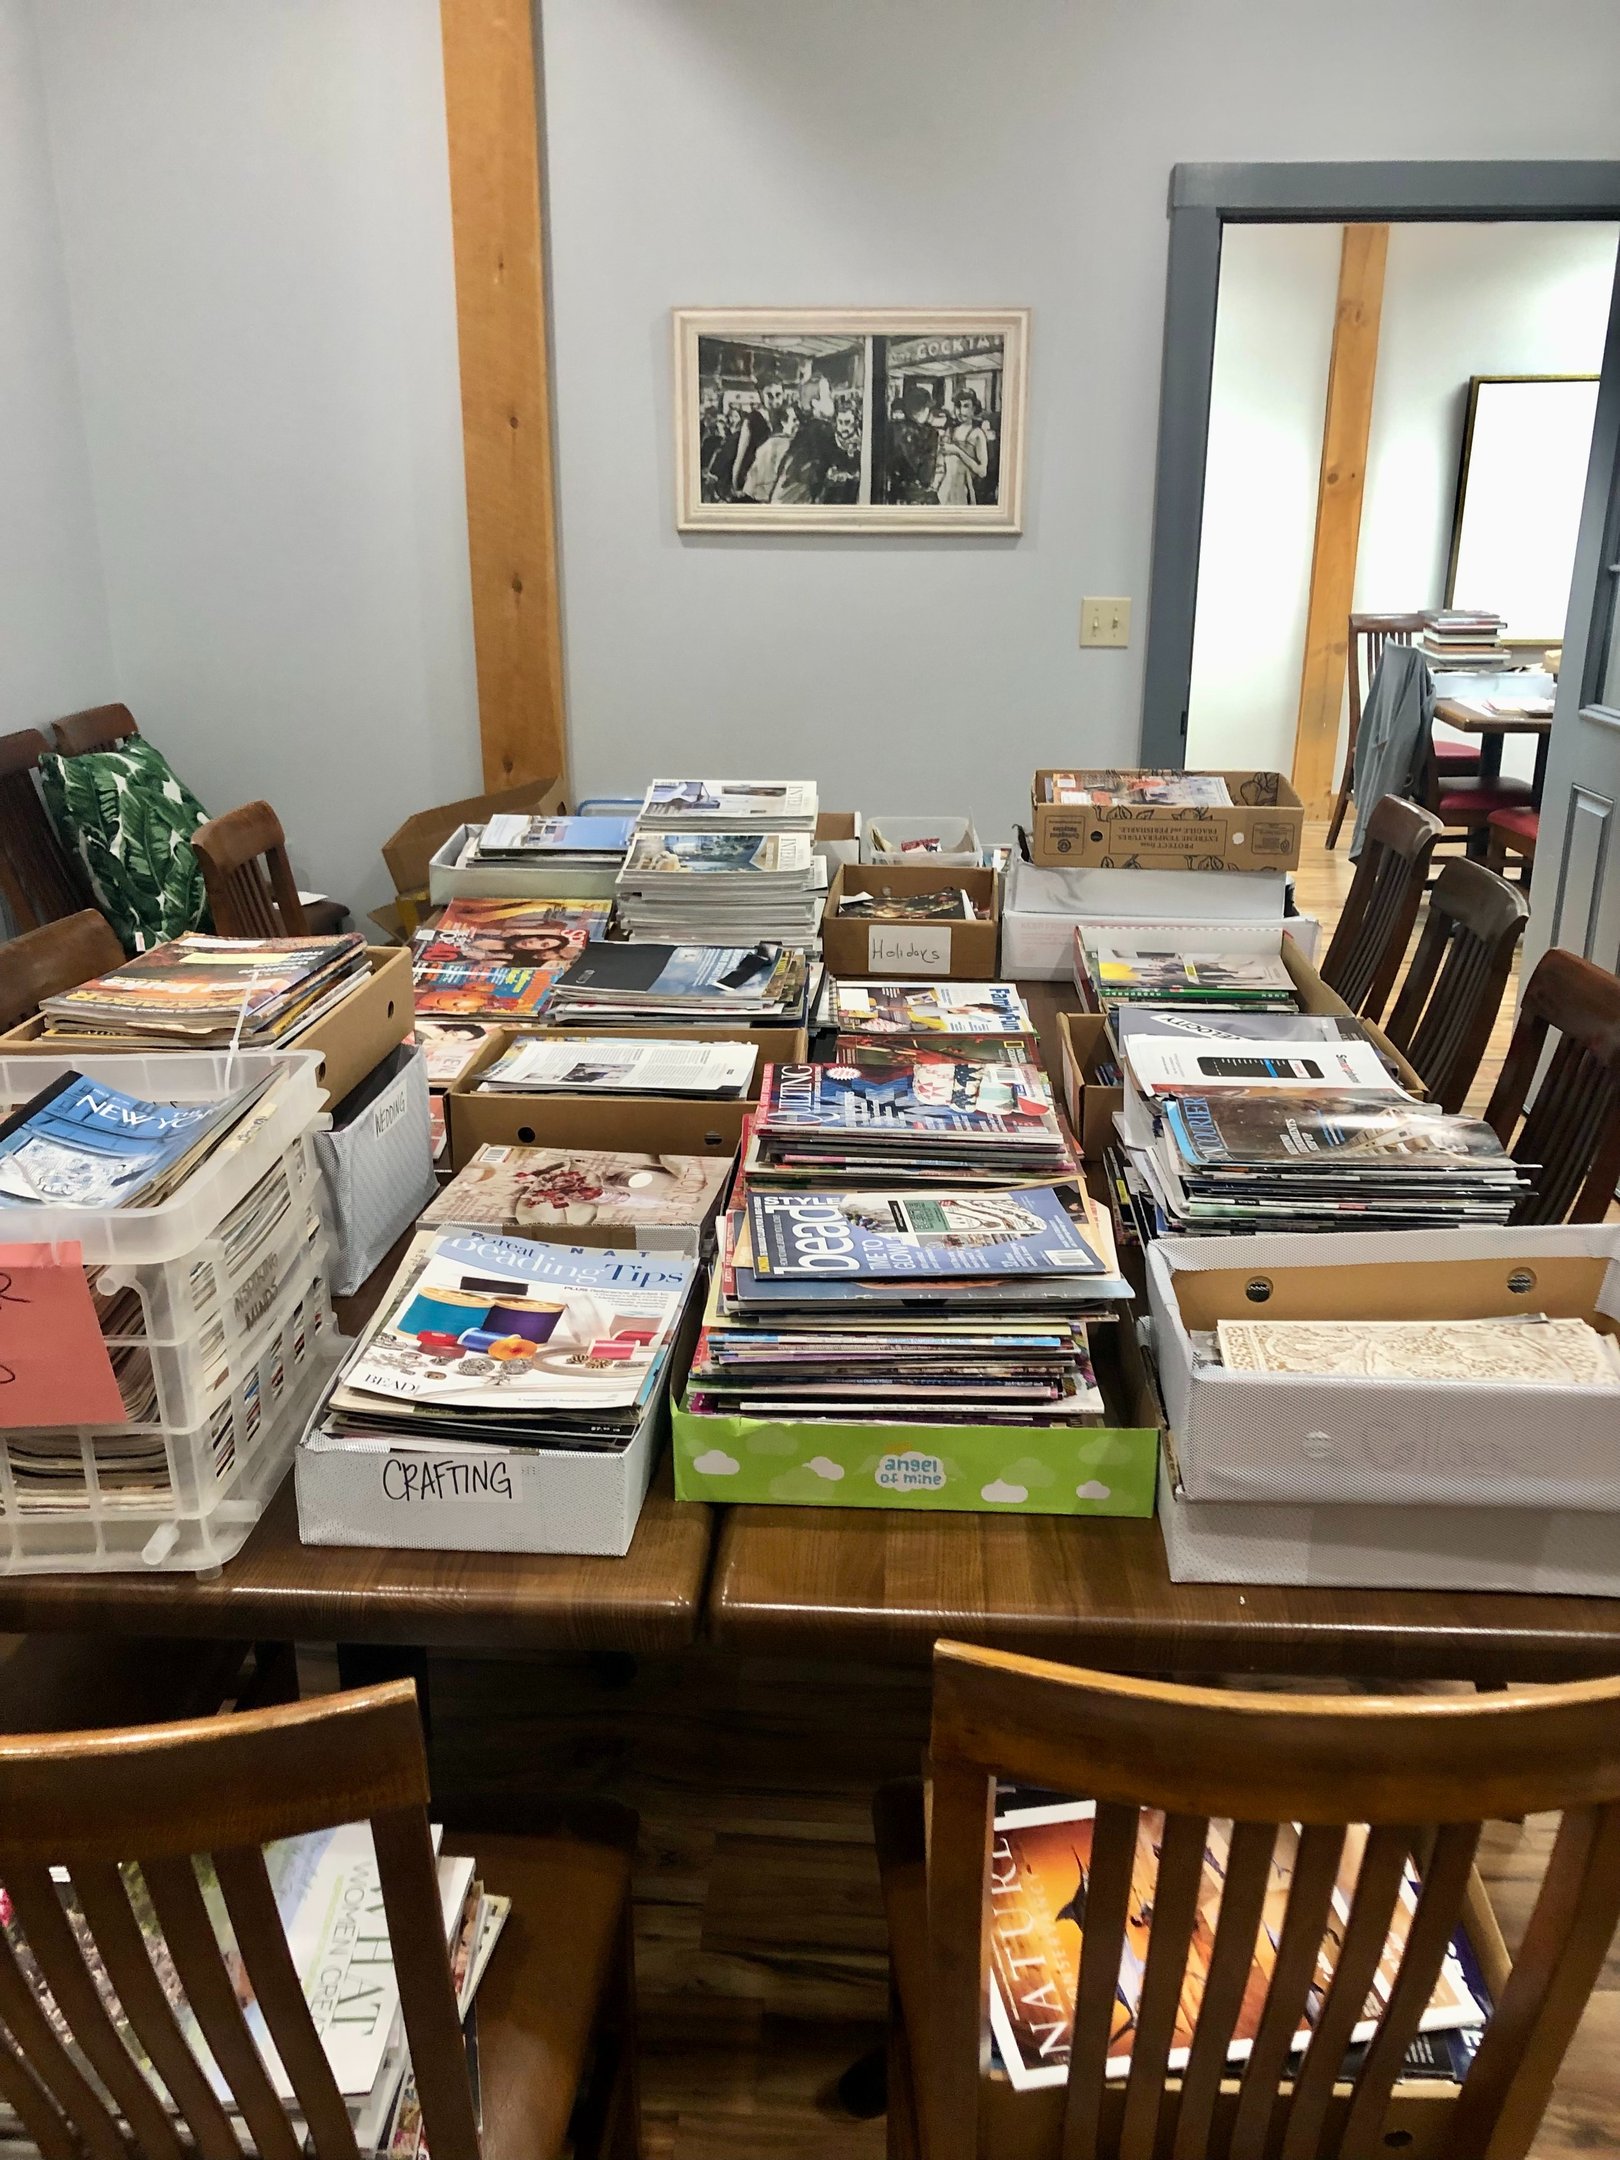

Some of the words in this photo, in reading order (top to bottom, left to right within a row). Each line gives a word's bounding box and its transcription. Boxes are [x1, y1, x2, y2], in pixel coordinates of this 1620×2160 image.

[871, 939, 941, 963] Holidays
[76, 1094, 153, 1127] NEW
[764, 1204, 861, 1275] bead
[603, 1263, 683, 1288] Tips
[382, 1457, 515, 1502] CRAFTING
[880, 1473, 898, 1484] of
[903, 1473, 942, 1485] mine
[885, 1458, 938, 1473] angel
[329, 1860, 373, 1956] WOMEN
